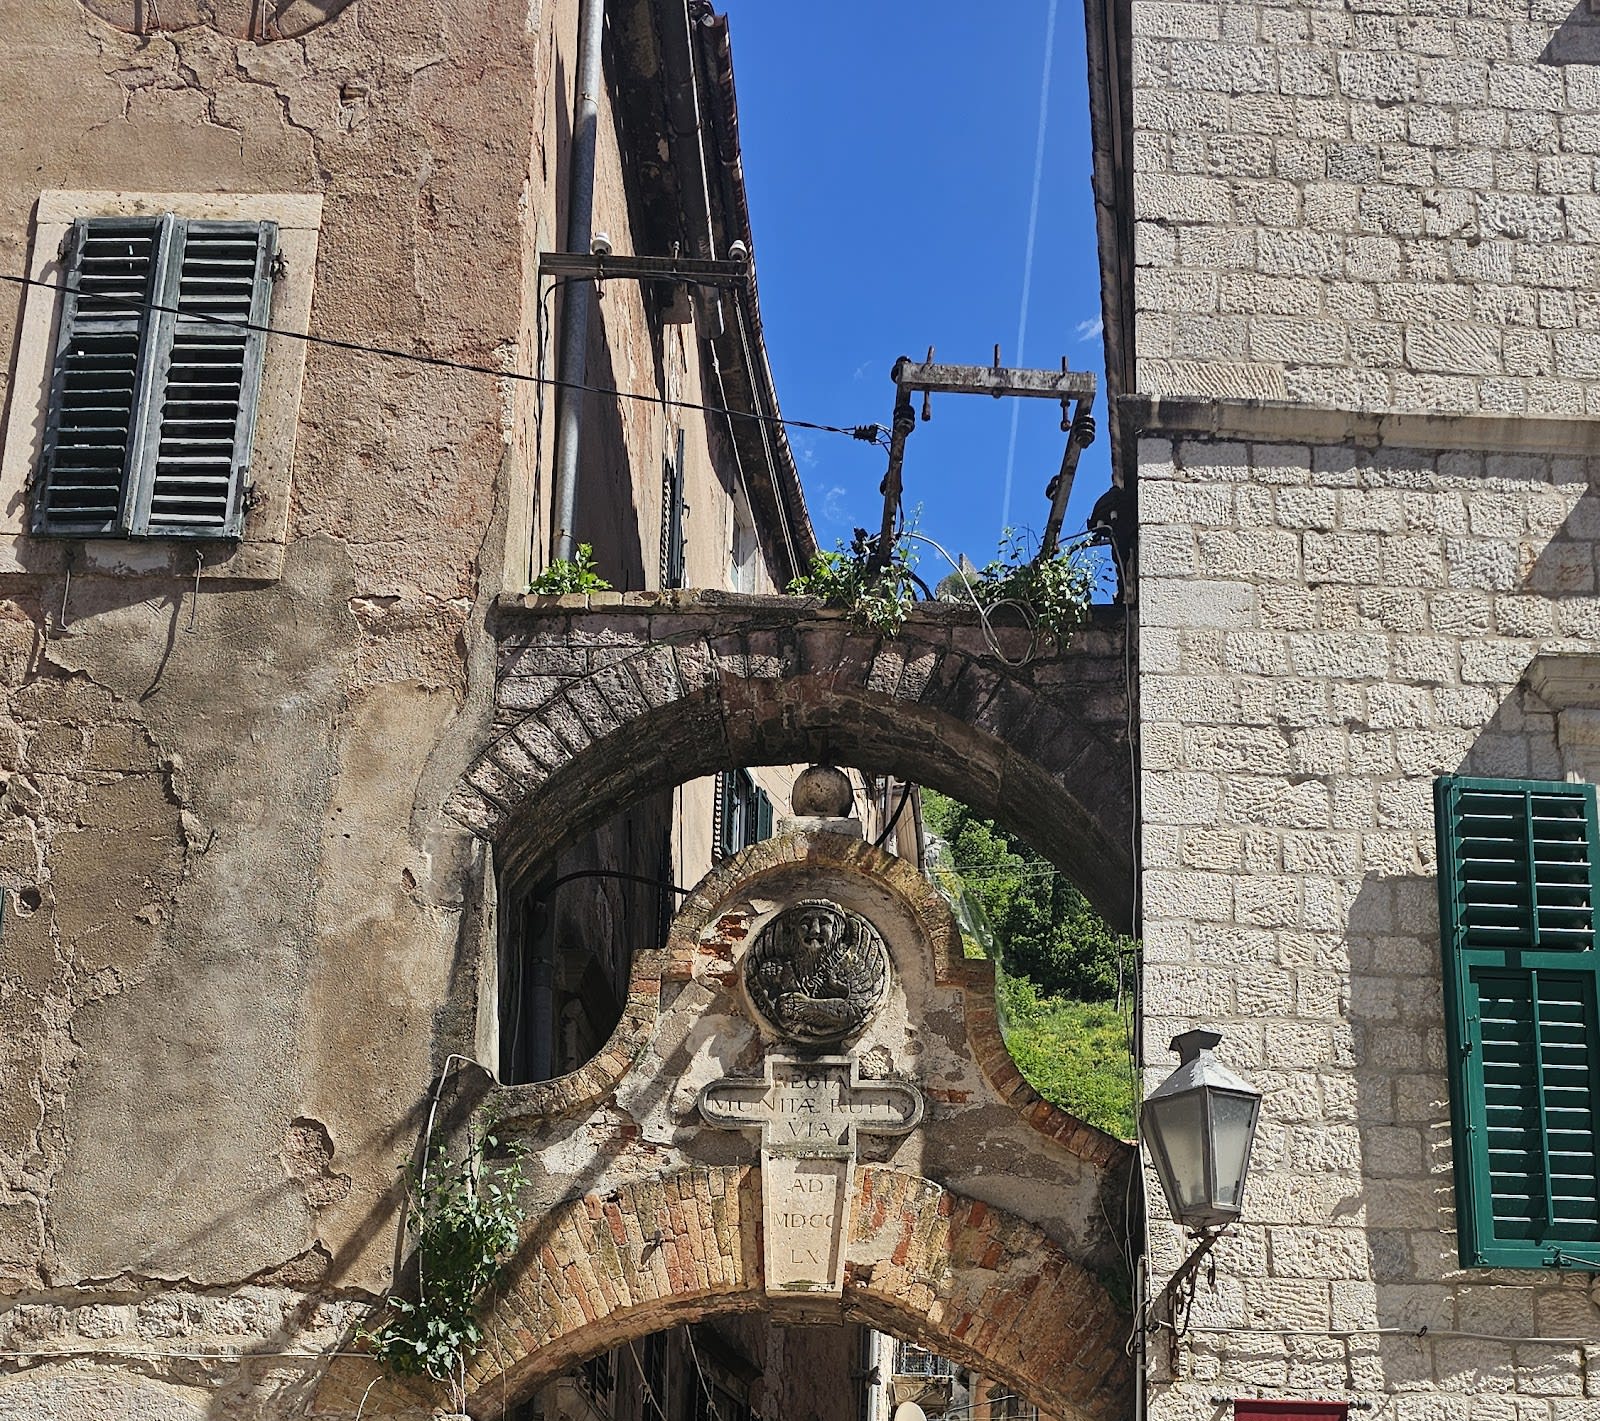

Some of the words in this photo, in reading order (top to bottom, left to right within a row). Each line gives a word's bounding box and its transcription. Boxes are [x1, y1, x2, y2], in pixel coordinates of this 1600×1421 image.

[772, 1074, 850, 1090] REGIA
[711, 1098, 821, 1114] MUNITÆ
[830, 1098, 909, 1114] RUPIS
[788, 1123, 834, 1138] VIA
[790, 1178, 824, 1193] AD
